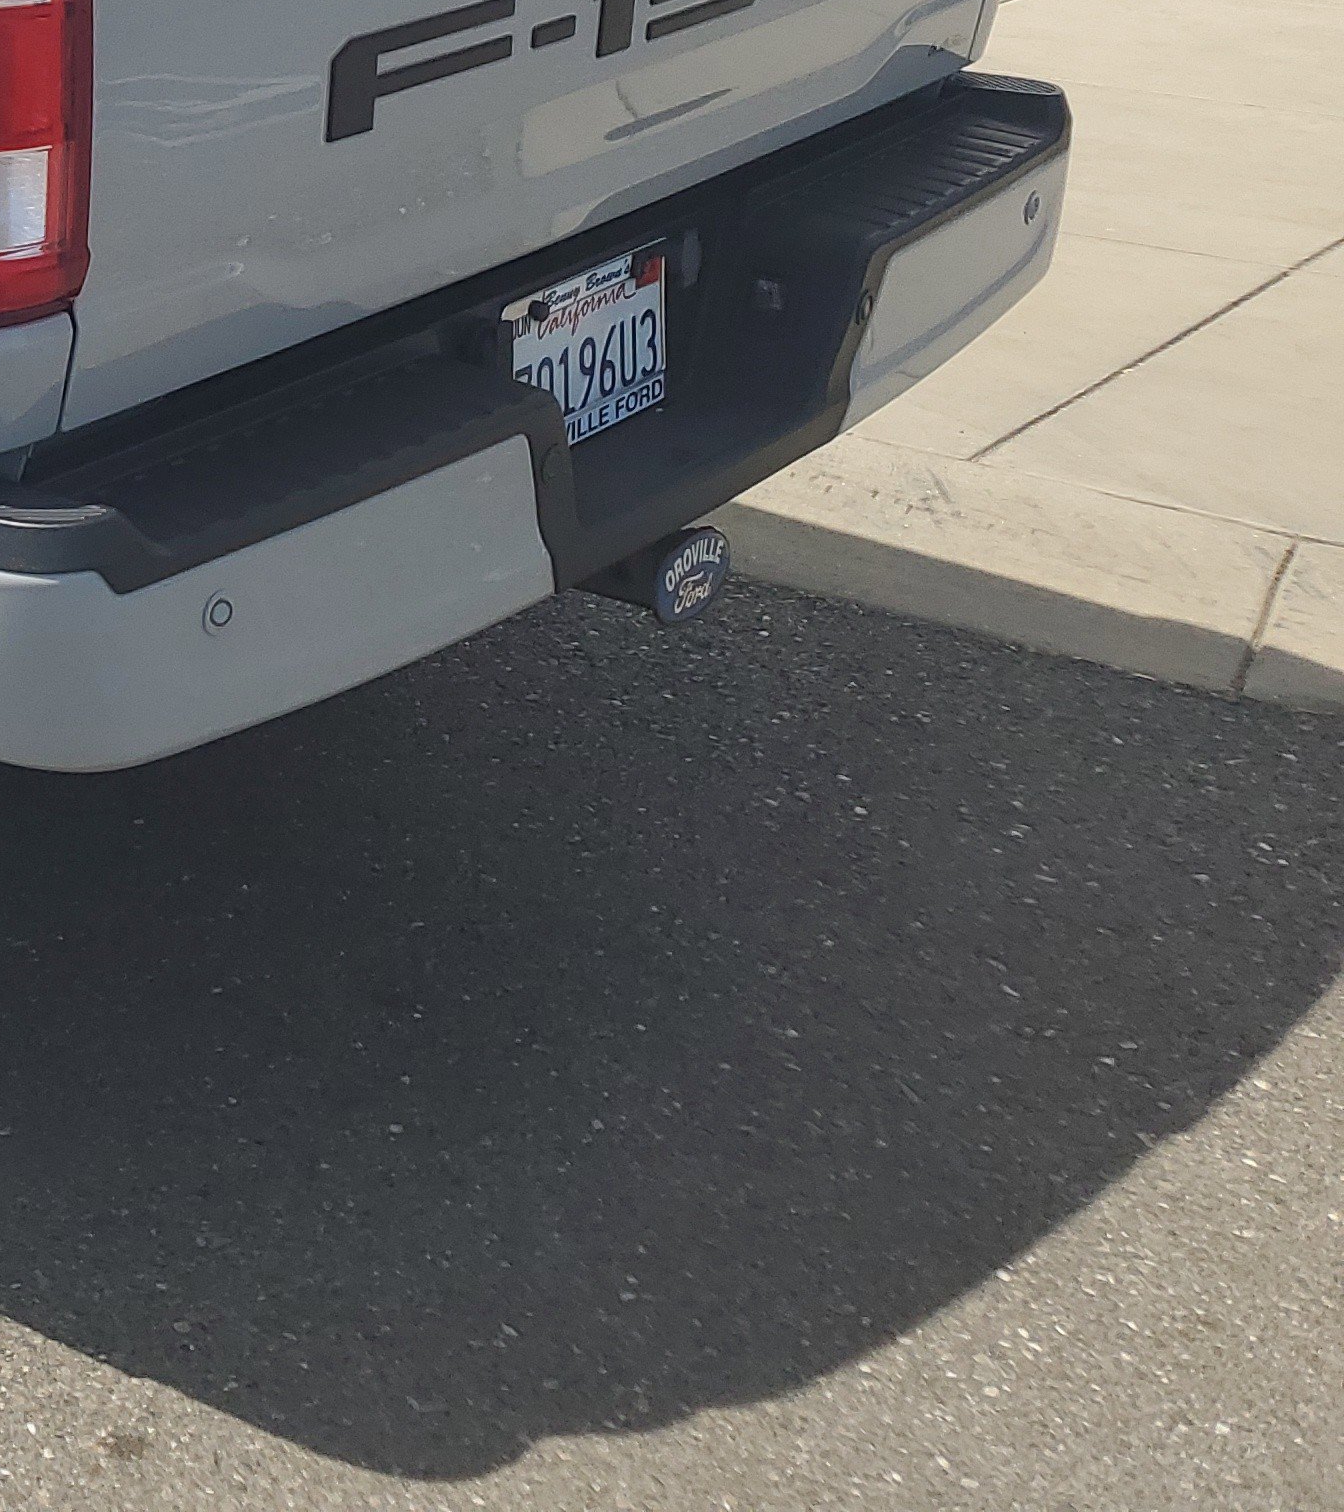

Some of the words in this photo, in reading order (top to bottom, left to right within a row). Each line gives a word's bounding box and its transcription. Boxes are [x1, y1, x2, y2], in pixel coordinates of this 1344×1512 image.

[537, 282, 637, 340] California
[615, 378, 663, 420] FORD
[665, 537, 724, 593] OROVILLE
[674, 570, 713, 614] Ford
